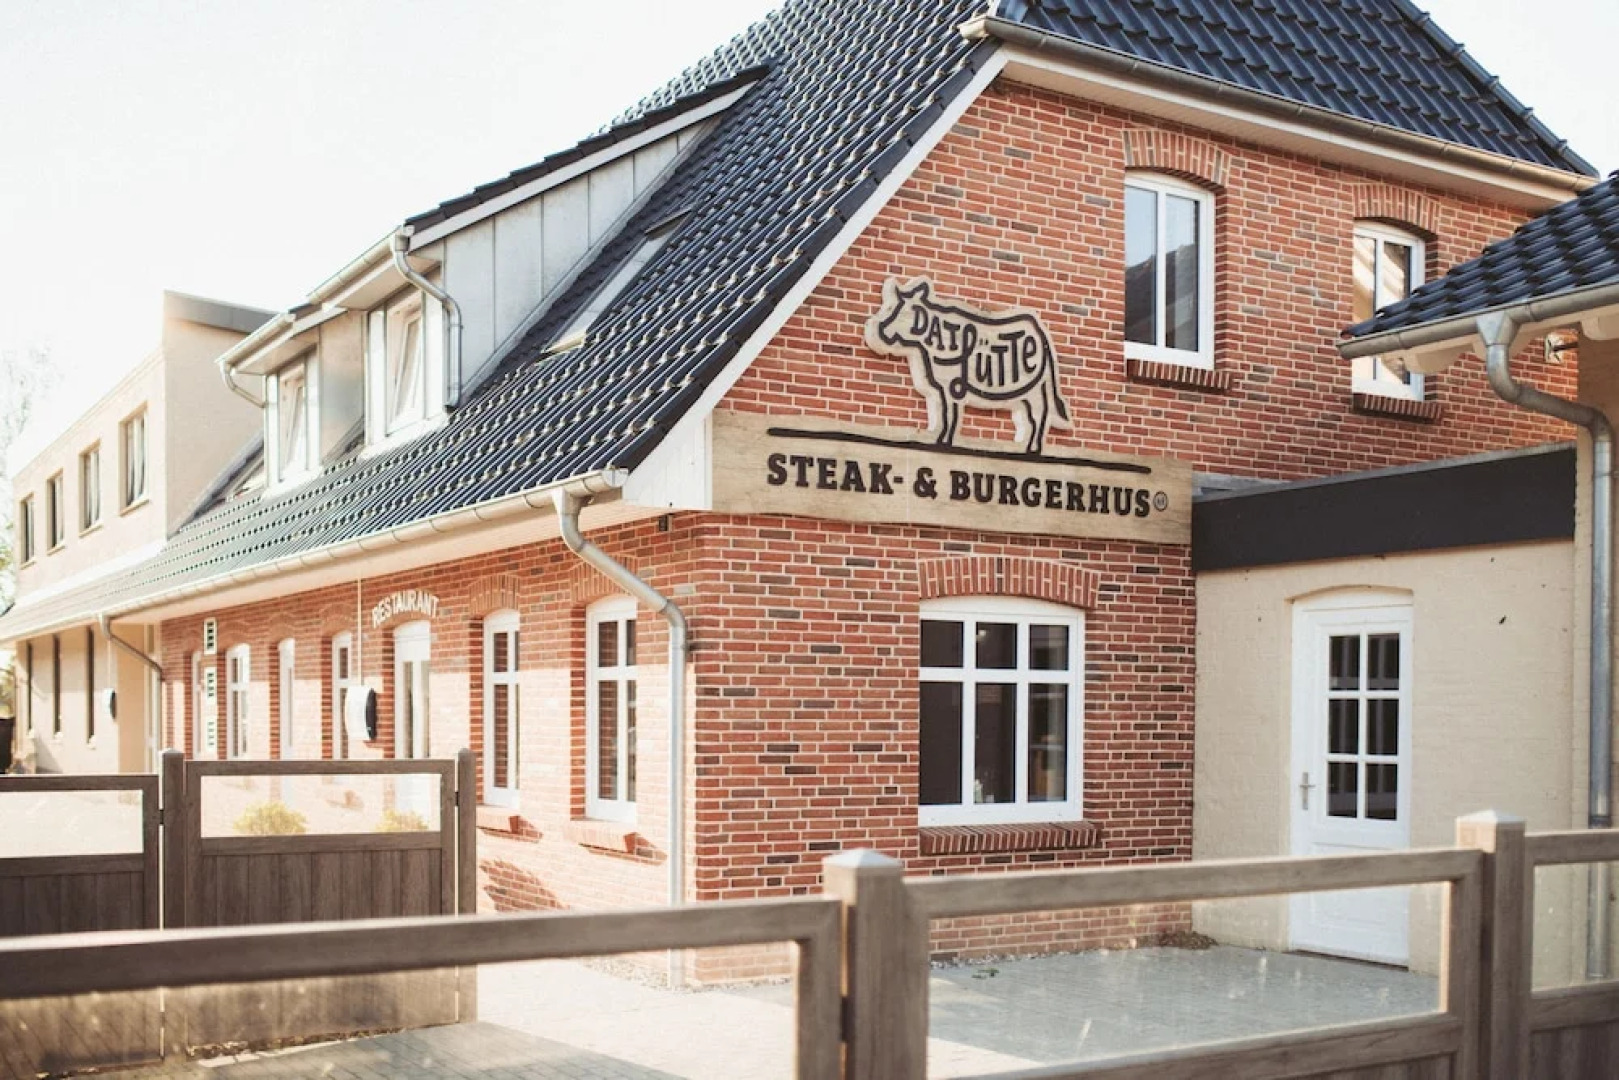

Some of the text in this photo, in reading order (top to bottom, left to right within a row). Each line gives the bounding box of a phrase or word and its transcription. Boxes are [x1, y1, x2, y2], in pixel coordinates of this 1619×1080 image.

[910, 304, 960, 351] DAT
[767, 453, 904, 495] STEAK-
[913, 466, 938, 500] &
[950, 470, 1150, 517] BURGERHUS
[372, 589, 439, 628] RESTAURANT
